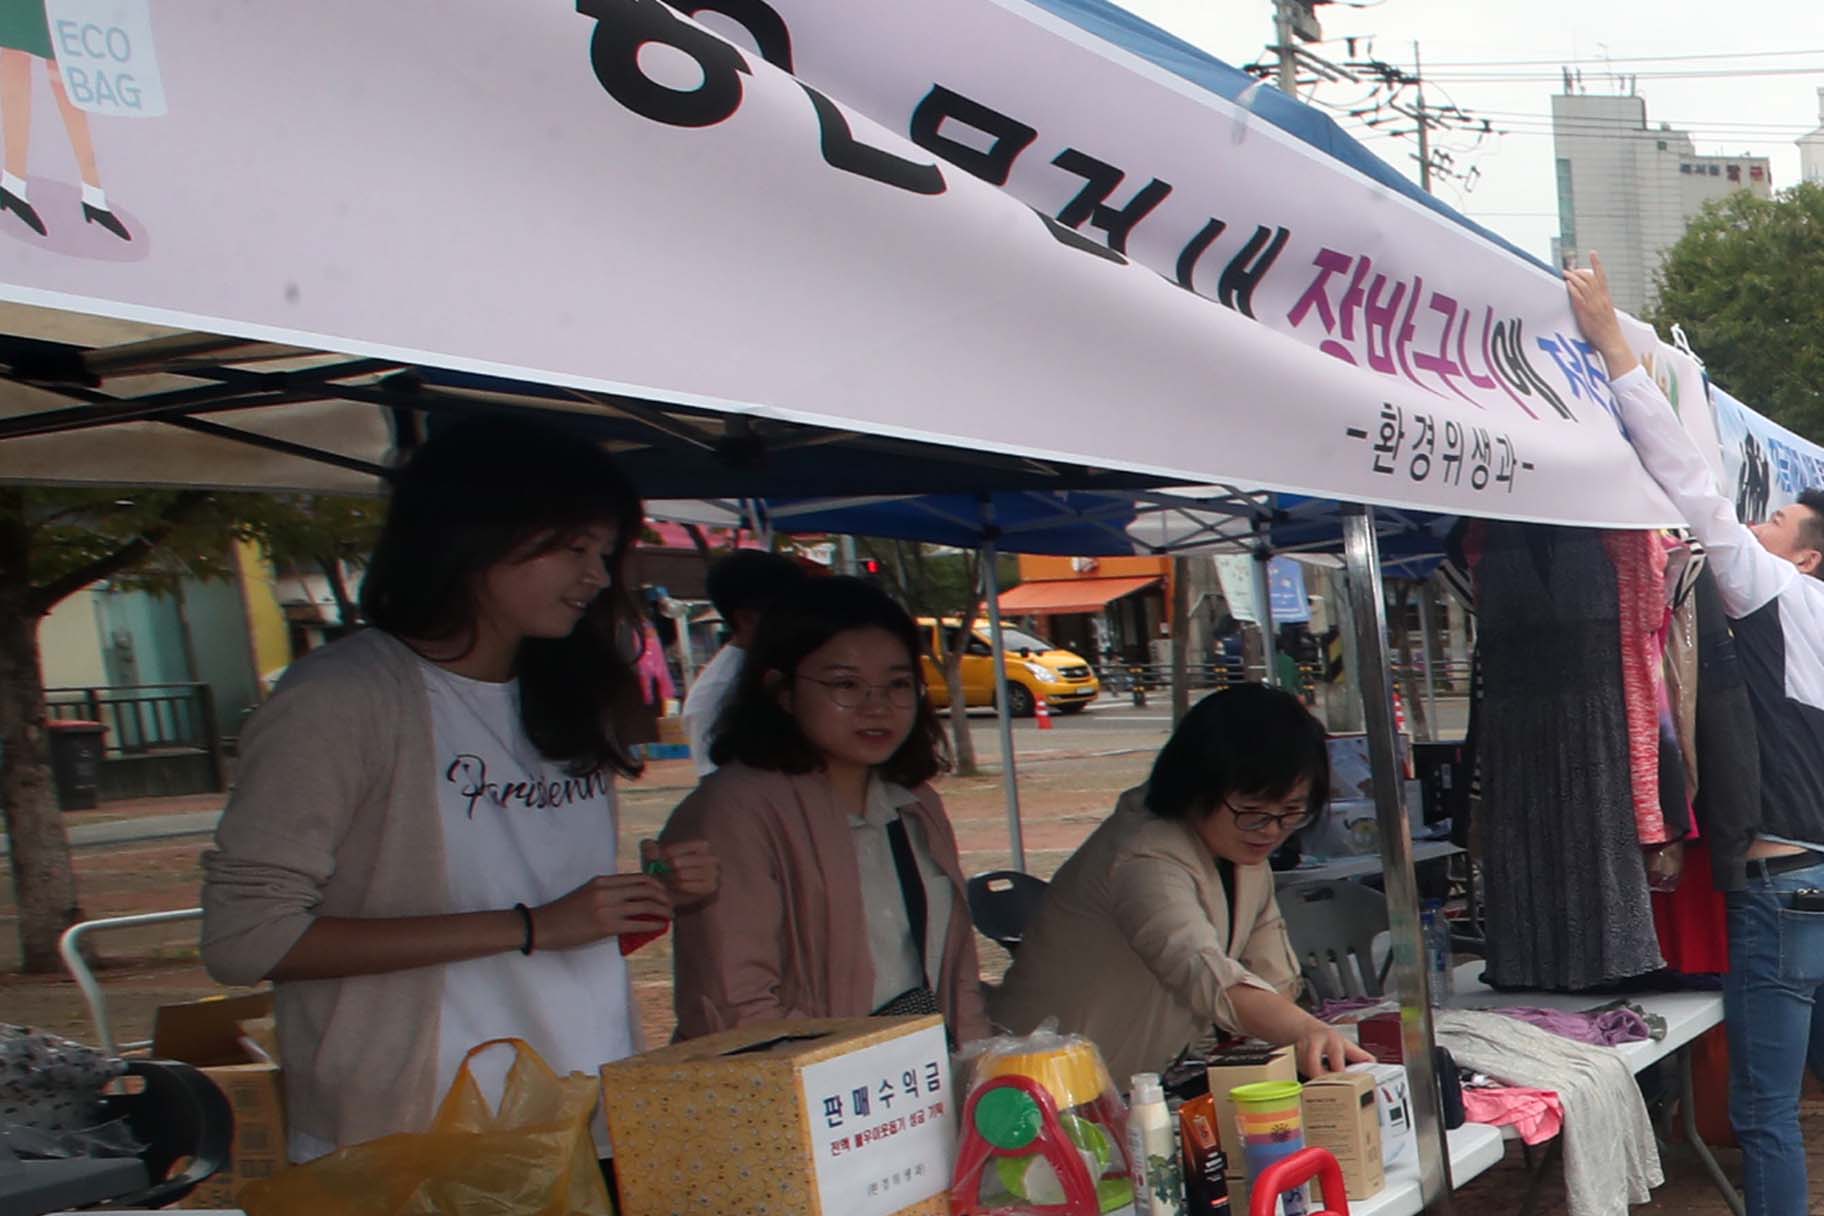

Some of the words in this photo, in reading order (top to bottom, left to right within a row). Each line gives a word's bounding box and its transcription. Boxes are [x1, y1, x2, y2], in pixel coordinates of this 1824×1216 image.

[55, 19, 131, 62] ECO
[64, 66, 142, 110] BAG
[1286, 247, 1578, 424] 장바구니에
